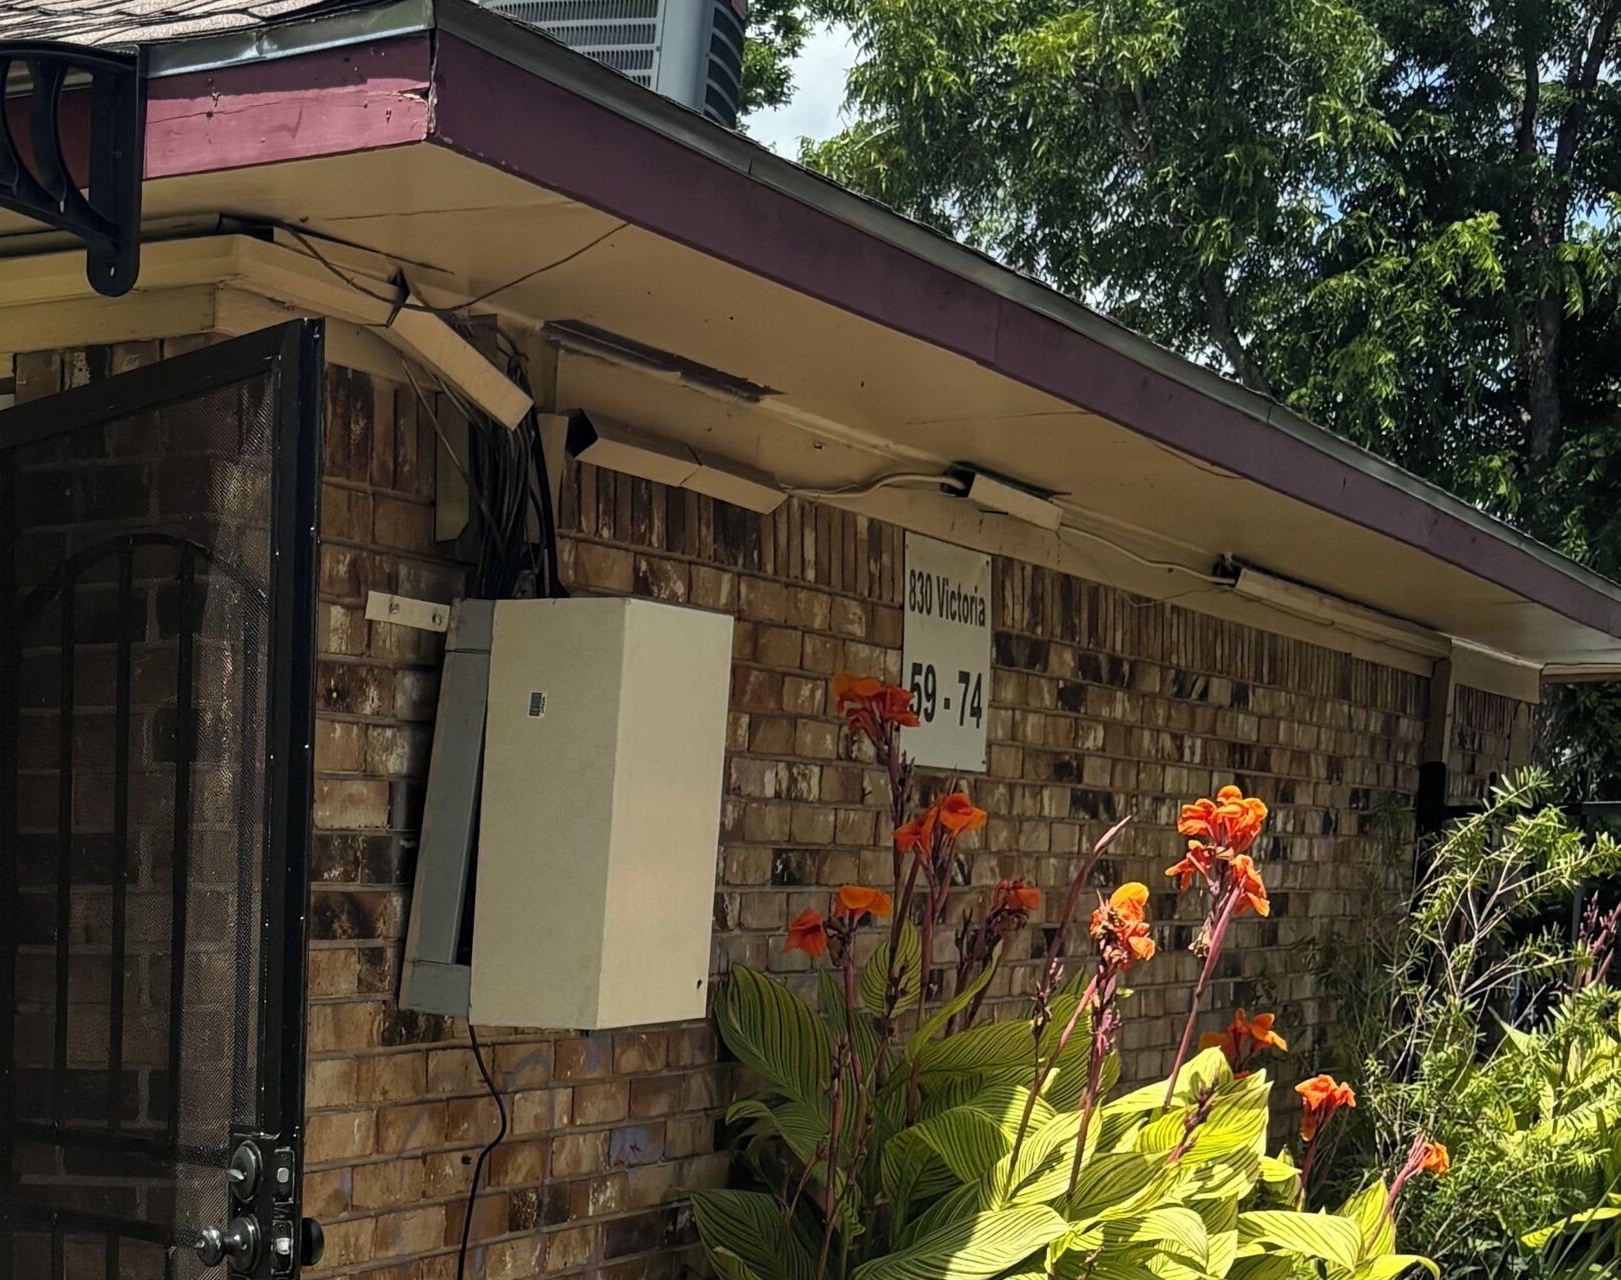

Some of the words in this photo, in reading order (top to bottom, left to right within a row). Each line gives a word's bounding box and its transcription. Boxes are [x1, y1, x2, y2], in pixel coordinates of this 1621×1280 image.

[909, 569, 932, 616] 830
[937, 576, 986, 628] Victoria
[910, 662, 937, 723] 59
[958, 670, 983, 729] 74
